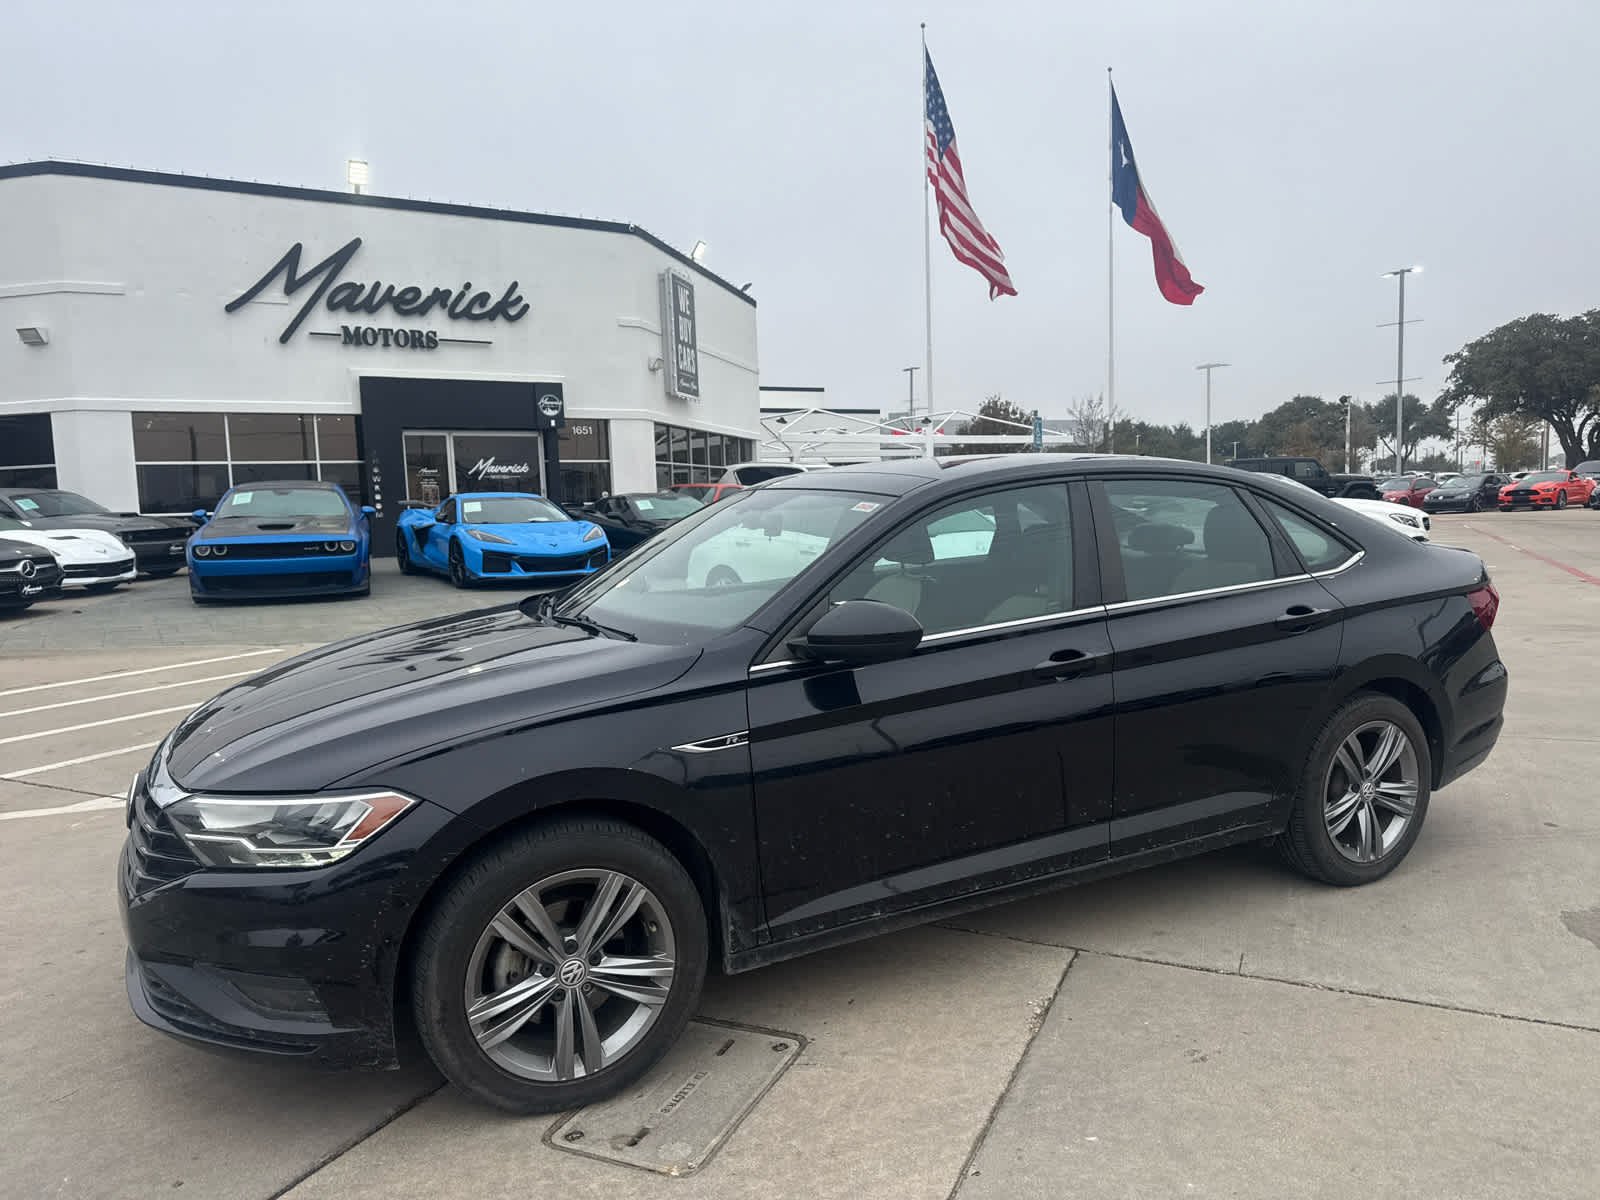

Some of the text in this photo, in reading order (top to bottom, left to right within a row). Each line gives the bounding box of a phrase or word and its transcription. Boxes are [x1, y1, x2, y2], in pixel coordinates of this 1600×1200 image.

[225, 237, 530, 344] Maverick
[678, 284, 691, 315] WE
[341, 325, 439, 349] MOTORS
[572, 425, 593, 435] 1651
[468, 456, 529, 480] Maverick
